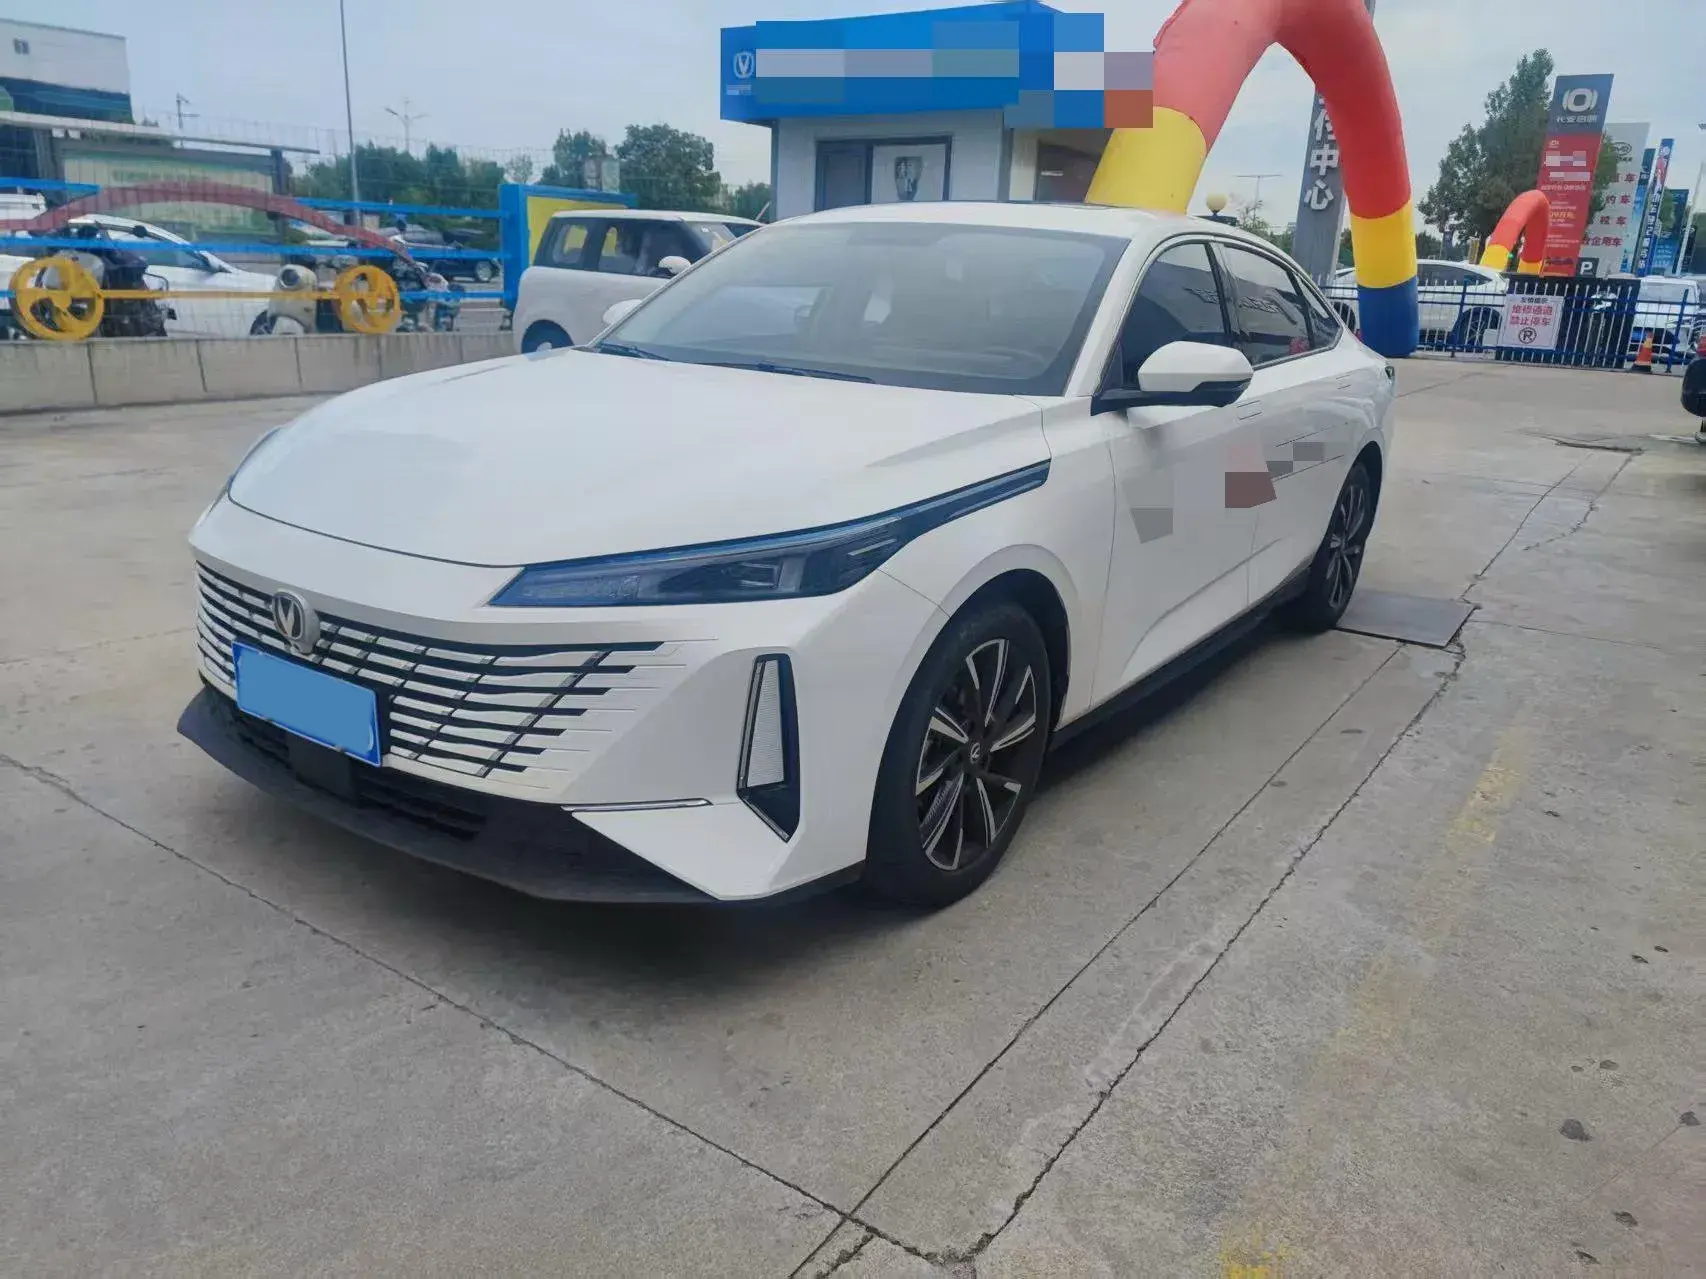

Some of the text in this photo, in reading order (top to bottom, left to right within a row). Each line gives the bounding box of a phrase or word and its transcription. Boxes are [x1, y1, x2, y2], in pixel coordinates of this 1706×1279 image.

[1304, 98, 1339, 210] 付中心
[1580, 261, 1593, 275] P
[1511, 304, 1553, 315] 维修通道
[1509, 316, 1551, 326] 禁止停车
